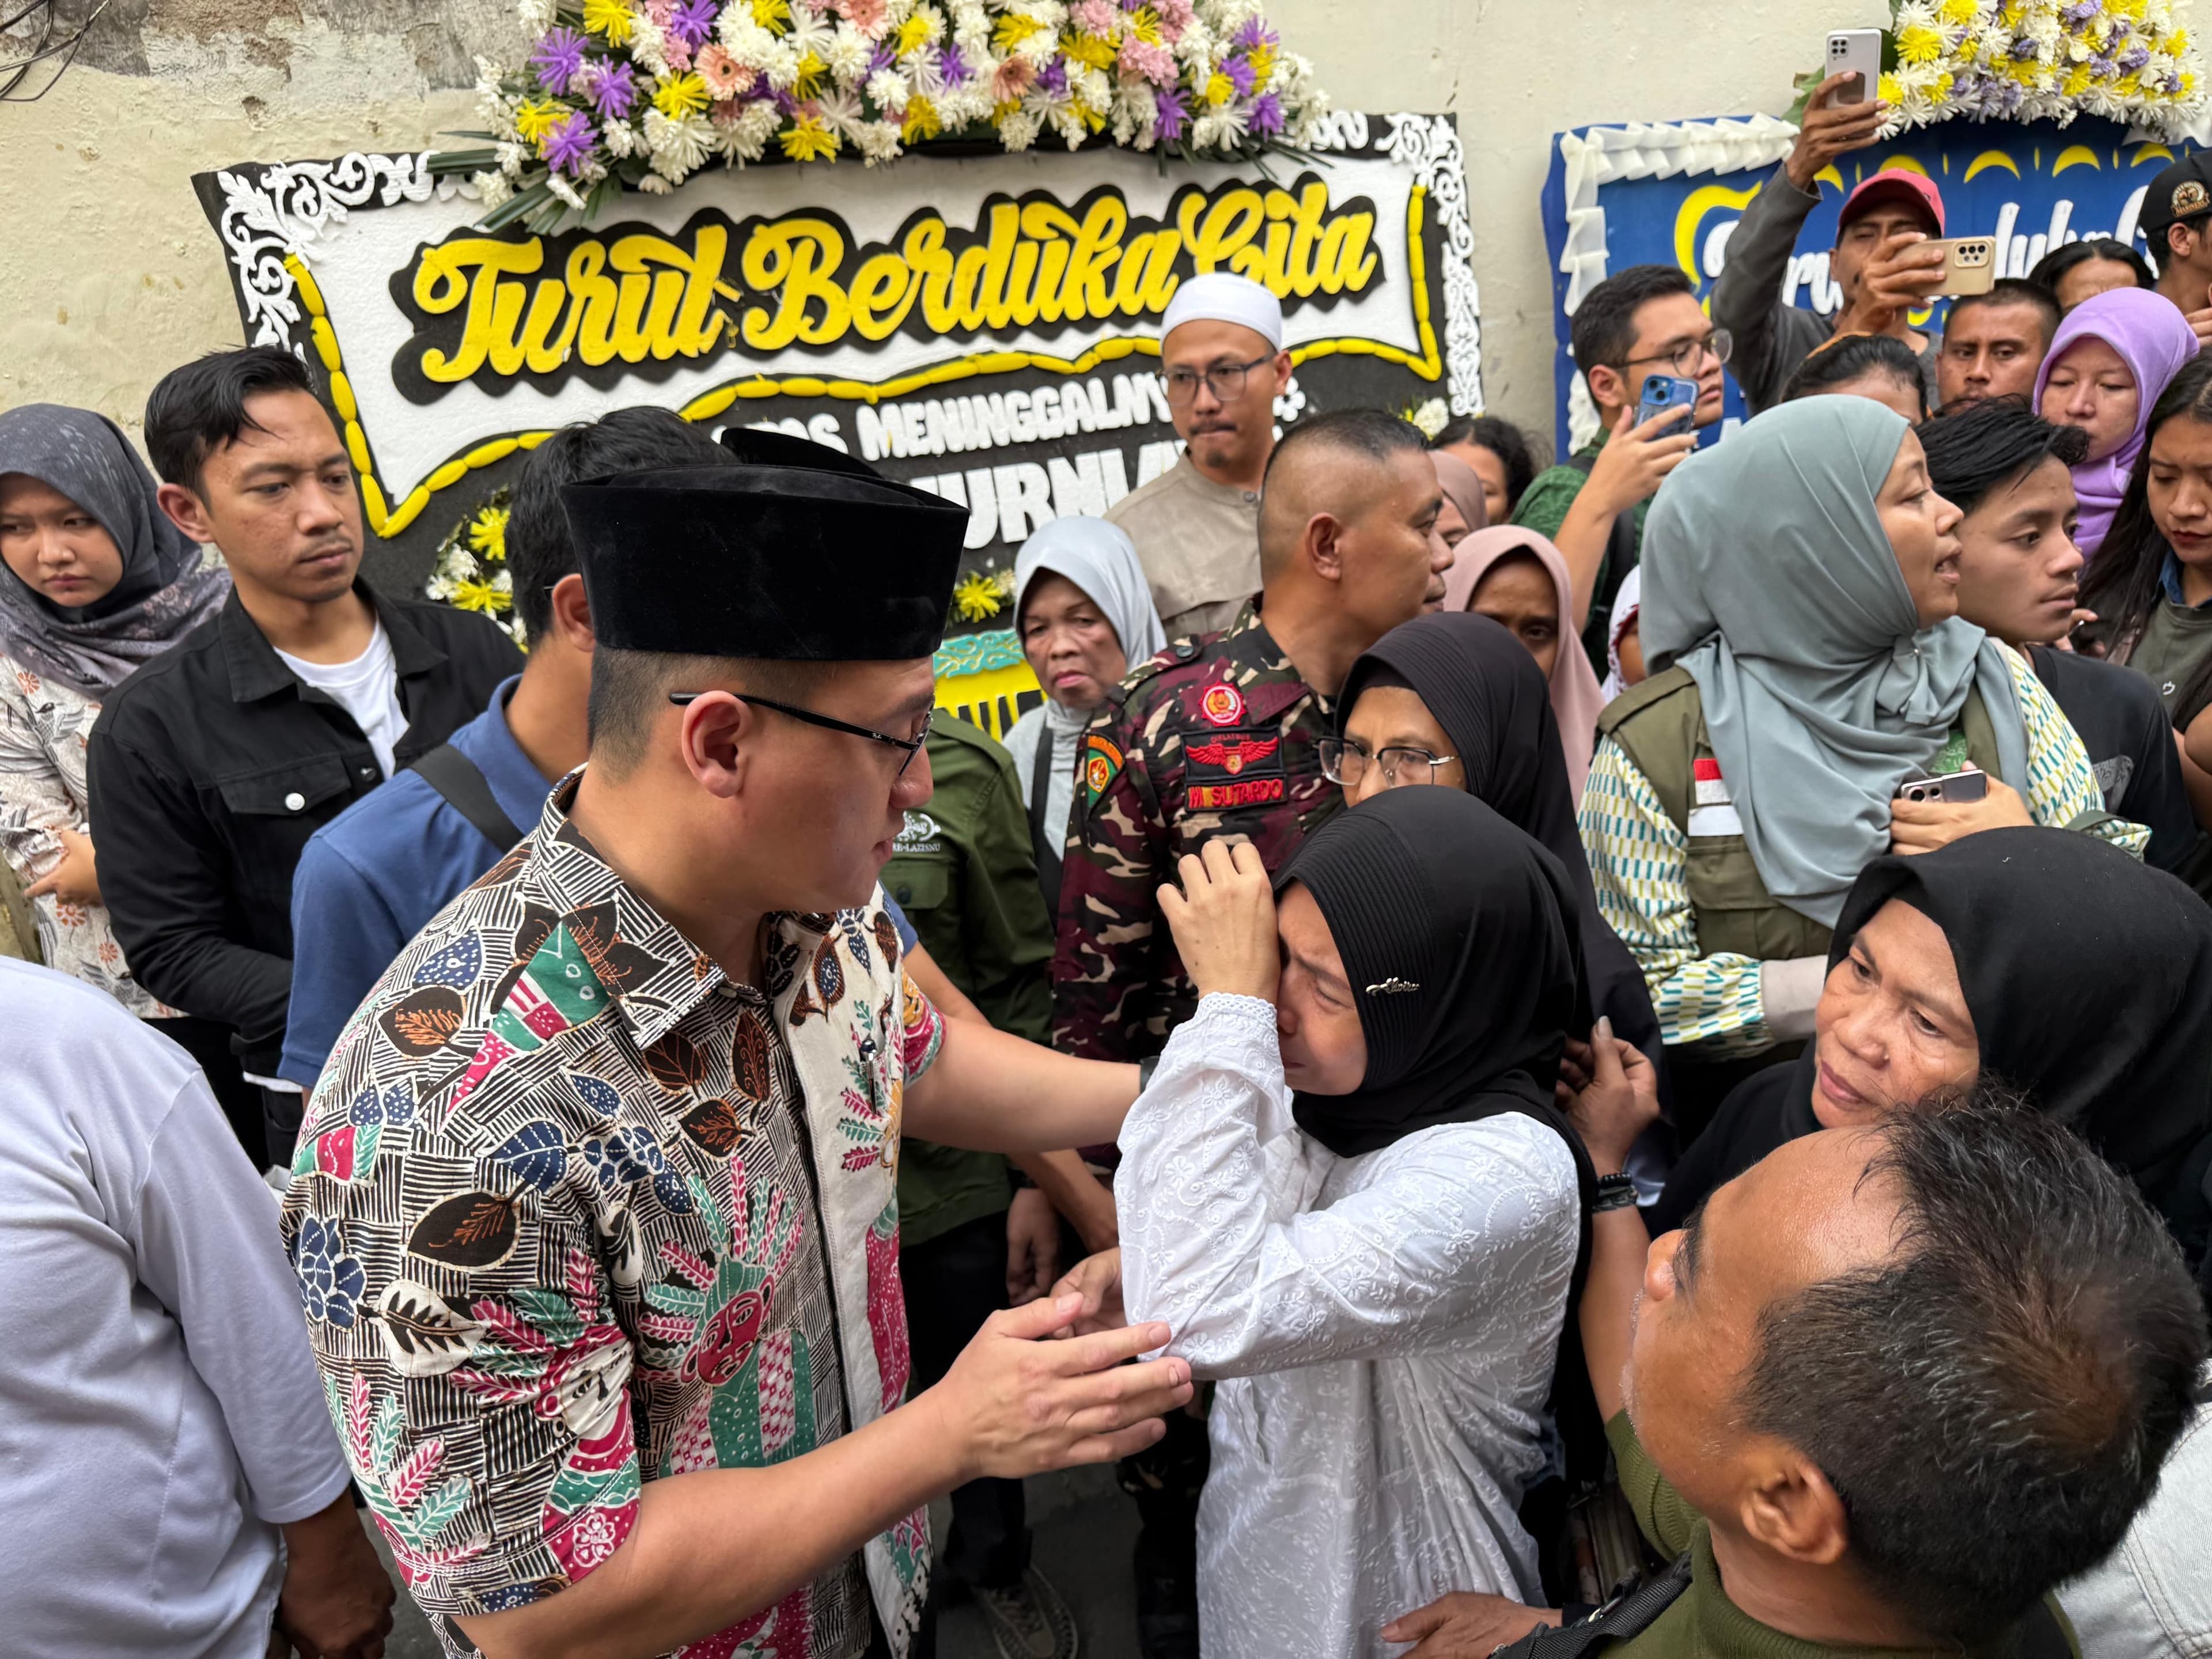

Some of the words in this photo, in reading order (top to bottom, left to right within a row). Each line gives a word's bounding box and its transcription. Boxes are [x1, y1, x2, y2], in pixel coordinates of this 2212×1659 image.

[414, 224, 742, 382] Turut
[741, 195, 1182, 350] Berduka
[1176, 182, 1378, 298] Cita
[857, 372, 1173, 461] MENINGGALNY
[1211, 778, 1283, 806] SUTARDO
